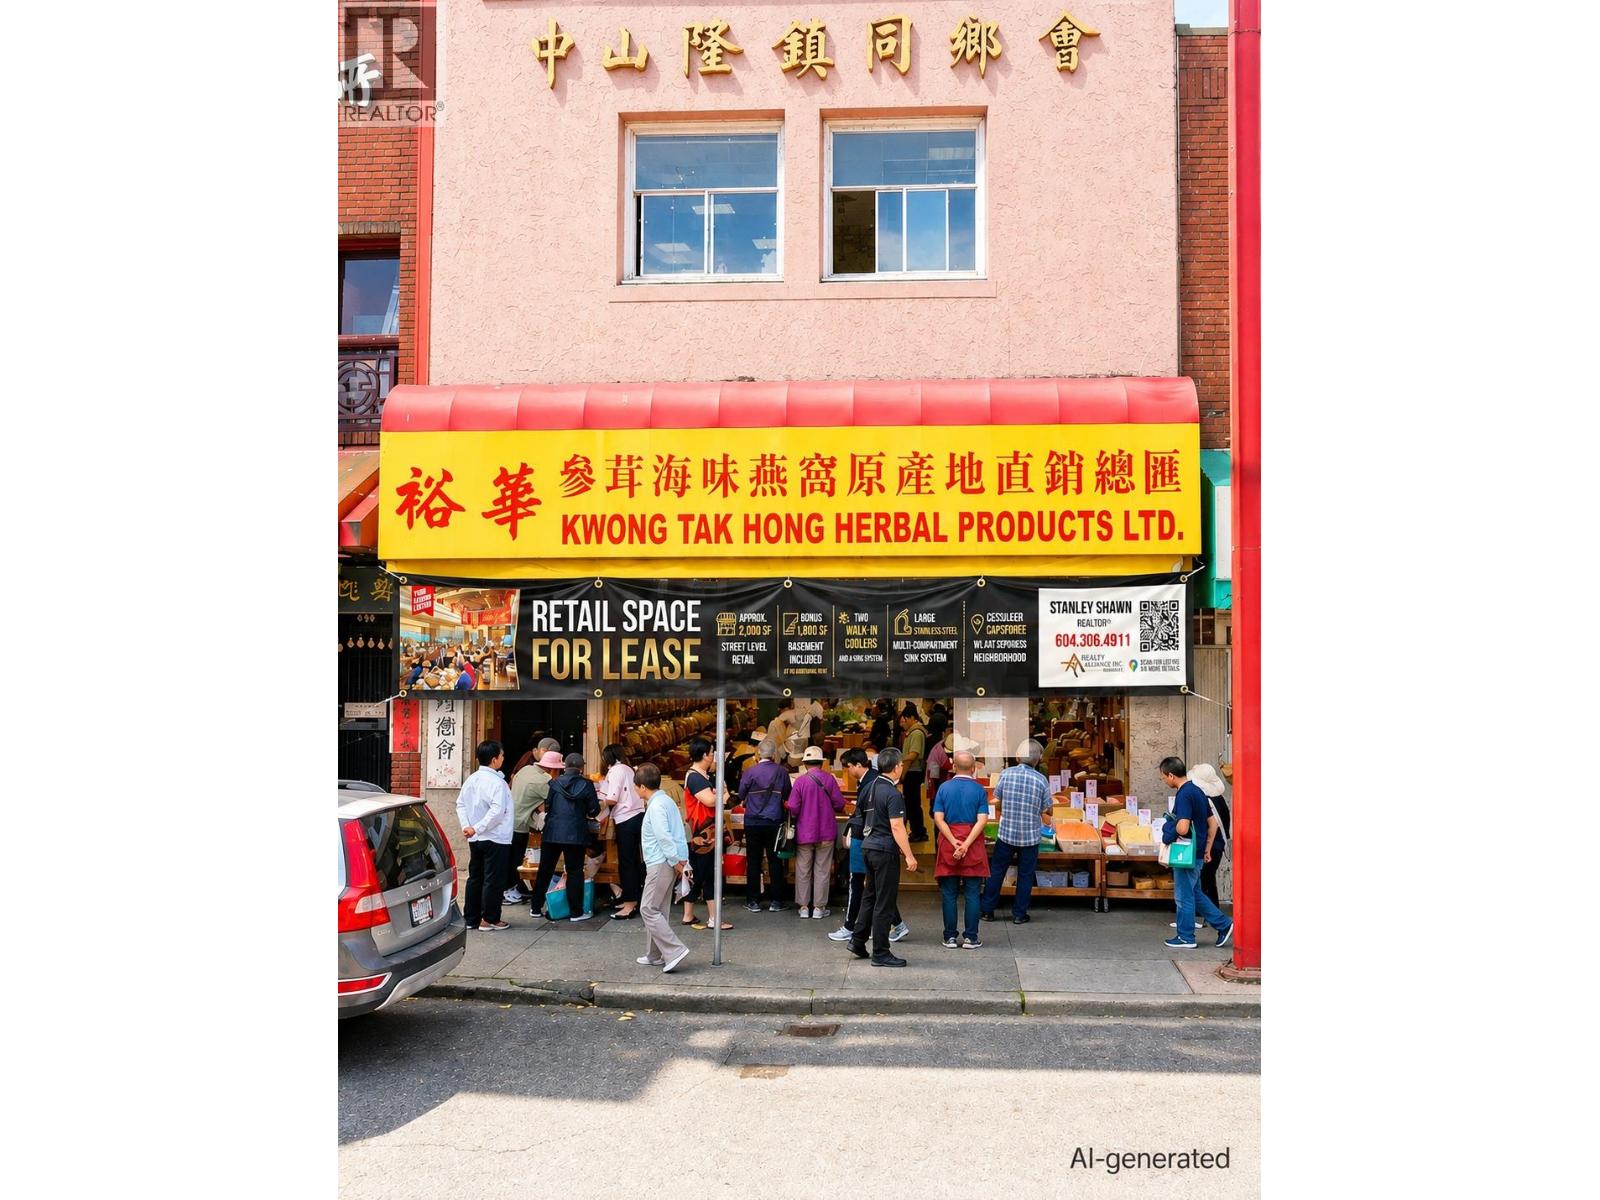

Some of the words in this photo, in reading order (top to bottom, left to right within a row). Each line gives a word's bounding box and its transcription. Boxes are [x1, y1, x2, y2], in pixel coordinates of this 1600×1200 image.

[531, 9, 1101, 89] 中山隆鎮同鄉會
[395, 462, 543, 541] 裕華
[561, 513, 668, 545] KWONG
[677, 513, 734, 544] TAK
[743, 512, 825, 544] HONG
[835, 511, 948, 543] HERBAL
[958, 510, 1114, 542] PRODUCTS
[1123, 509, 1184, 541] LTD.
[1050, 601, 1093, 614] STANLEY
[1097, 600, 1132, 614] SHAWN
[532, 600, 616, 632] RETAIL
[622, 599, 701, 632] SPACE
[800, 613, 823, 622] BONUS
[854, 613, 869, 622] TWO
[914, 613, 936, 622] LARGE
[738, 625, 761, 637] 2,000
[762, 625, 772, 636] SF
[797, 625, 818, 637] 1,800
[819, 625, 828, 636] SF
[846, 625, 878, 635] WALK-IN
[788, 641, 824, 651] BASEMENT
[844, 638, 878, 649] COOLERS
[1055, 633, 1130, 648] 604.306.4911
[721, 642, 746, 652] STREET
[747, 642, 767, 652] LEVEL
[532, 638, 593, 680] FOR
[602, 637, 702, 680] LEASE
[732, 654, 755, 665] RETAIL
[904, 653, 920, 663] SINK
[920, 653, 947, 663] SYSTEM
[973, 652, 1027, 662] NEIGHBORHOOD
